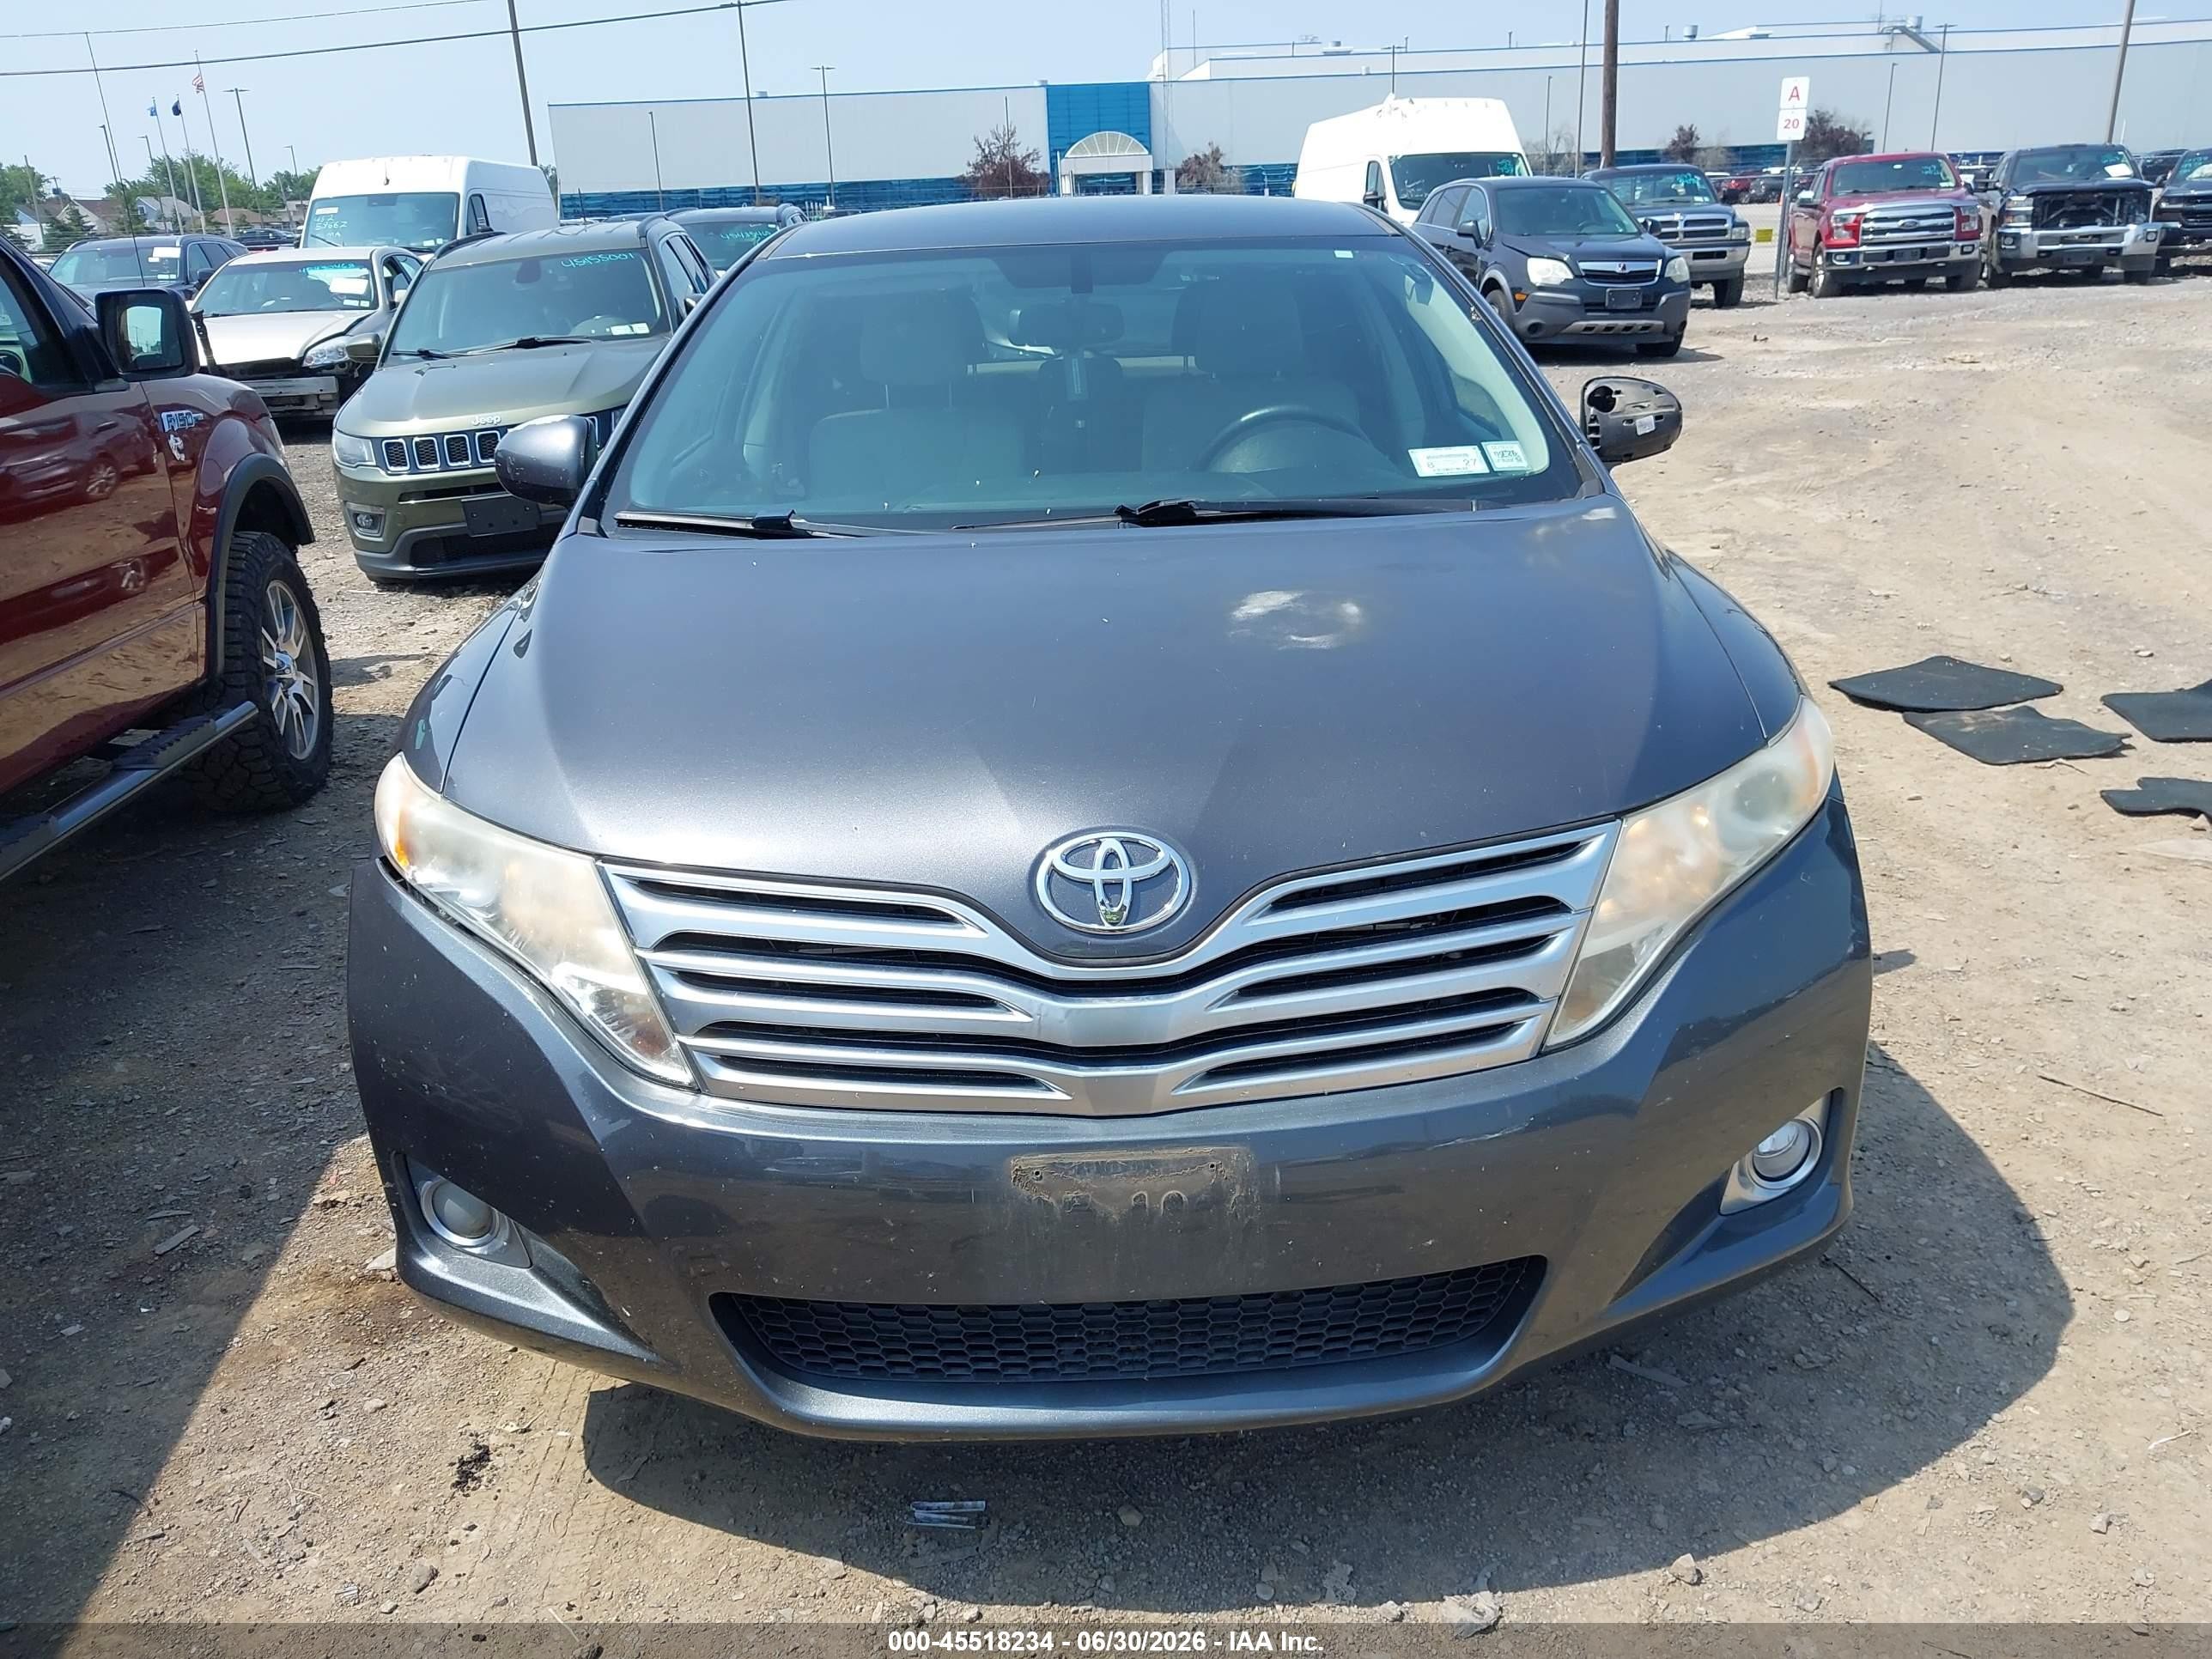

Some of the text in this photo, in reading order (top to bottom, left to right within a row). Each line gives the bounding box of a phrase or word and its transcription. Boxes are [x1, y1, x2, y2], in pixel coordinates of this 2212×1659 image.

[1789, 86, 1800, 101] A
[1784, 118, 1800, 130] 20
[471, 416, 501, 426] Jeep
